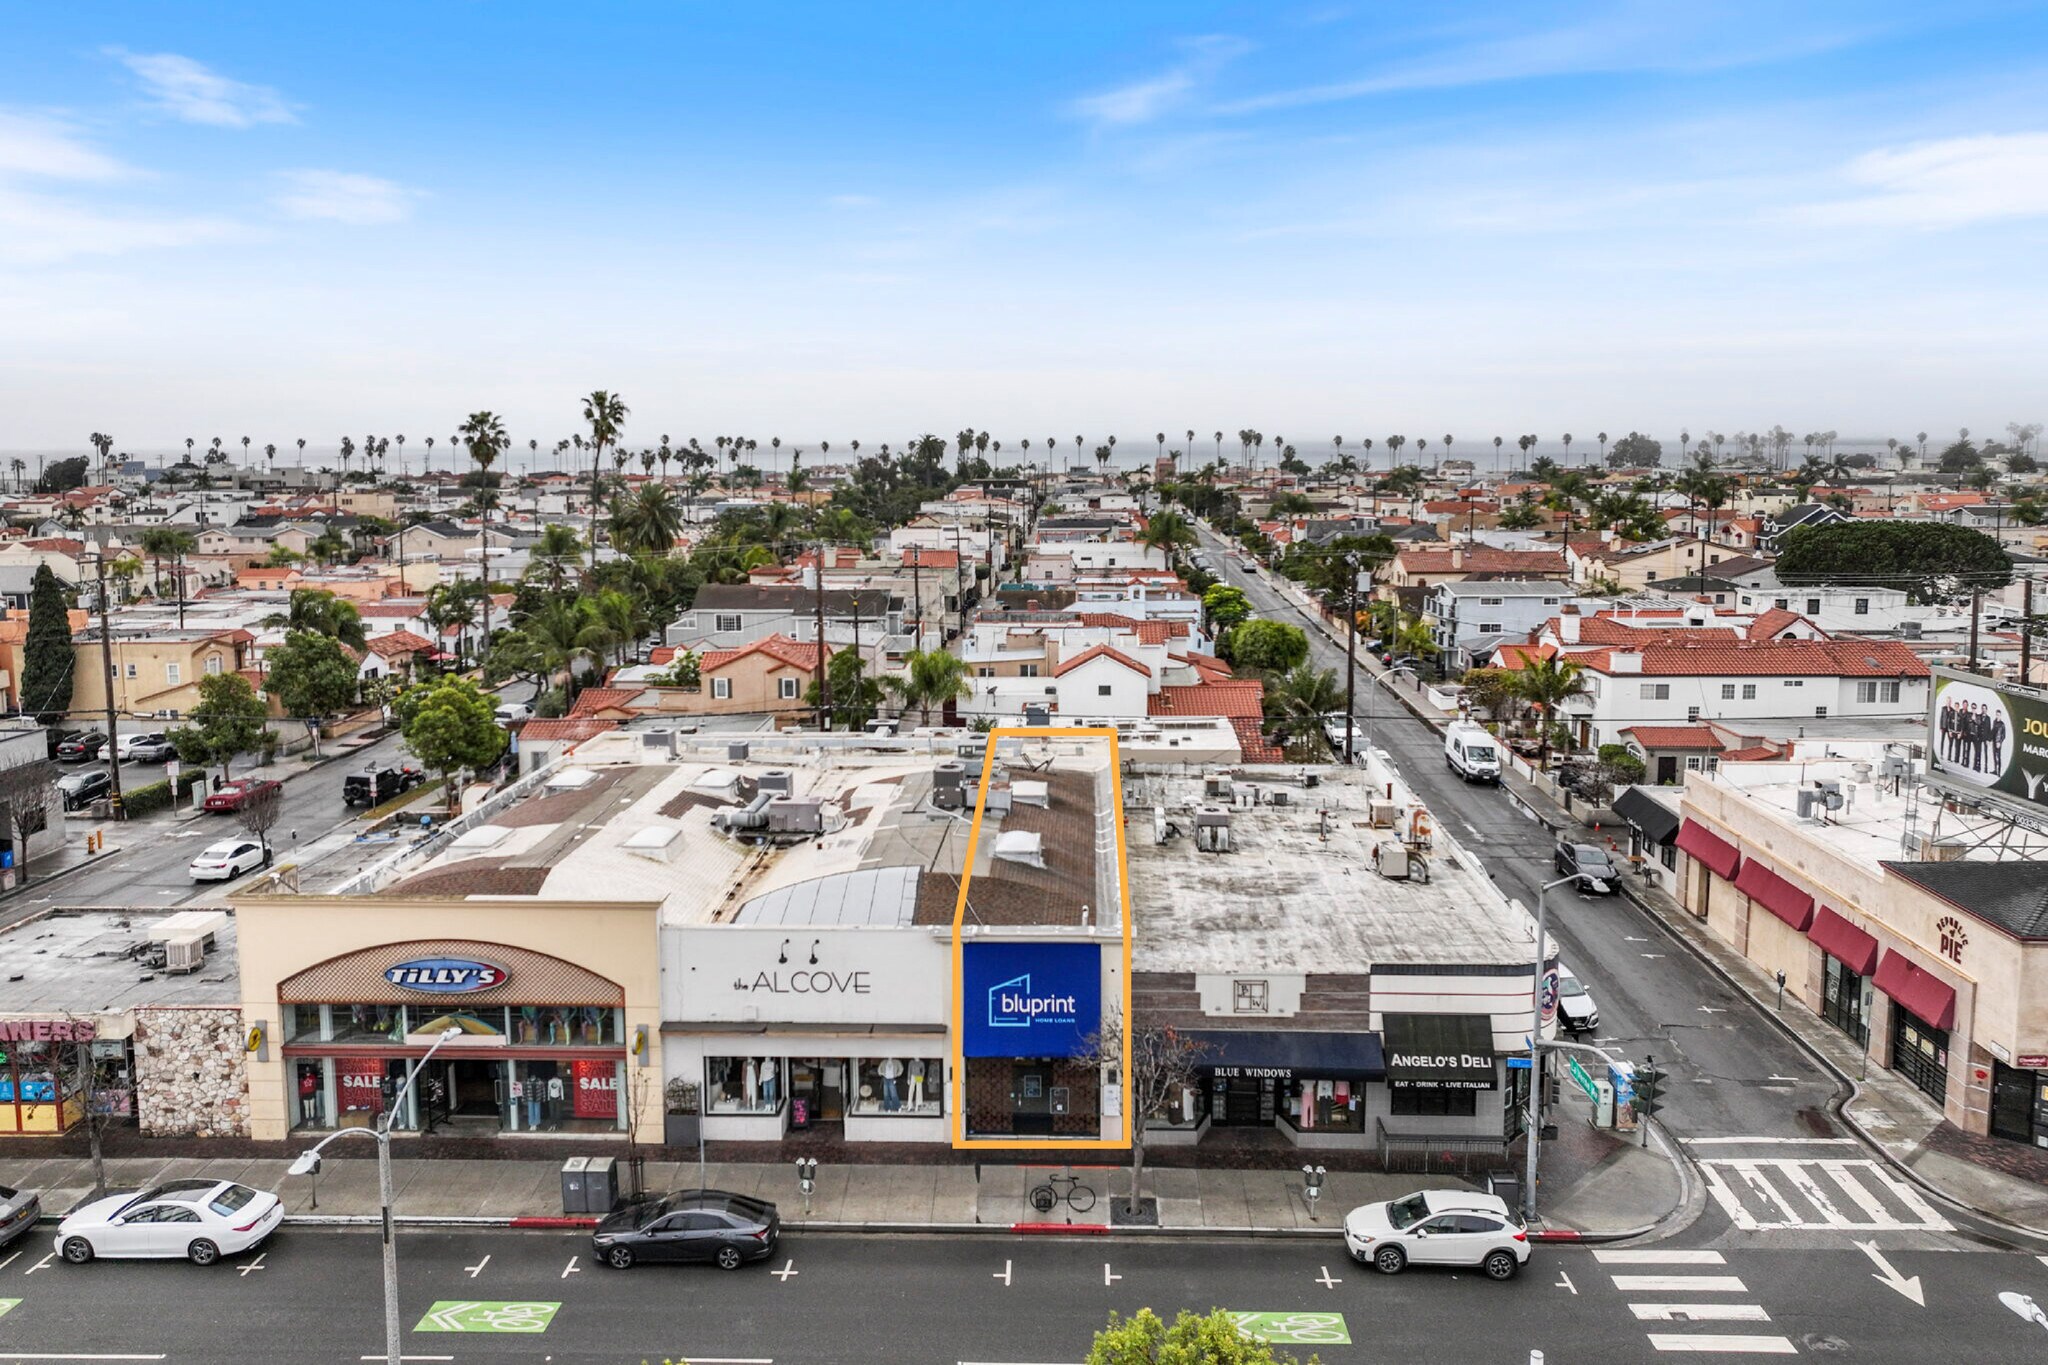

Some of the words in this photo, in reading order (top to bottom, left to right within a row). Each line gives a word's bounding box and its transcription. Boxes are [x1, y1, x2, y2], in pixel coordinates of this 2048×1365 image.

[1940, 933, 1963, 965] PIE
[733, 978, 749, 991] the
[752, 971, 871, 993] ALCOVE
[1002, 993, 1075, 1017] bluprint
[1391, 1054, 1458, 1068] ANGELO'S
[1461, 1054, 1492, 1069] DELI
[1214, 1067, 1239, 1077] BLUE
[1245, 1068, 1292, 1078] WINDOWS
[343, 1075, 381, 1088] SALE
[579, 1077, 618, 1090] SALE
